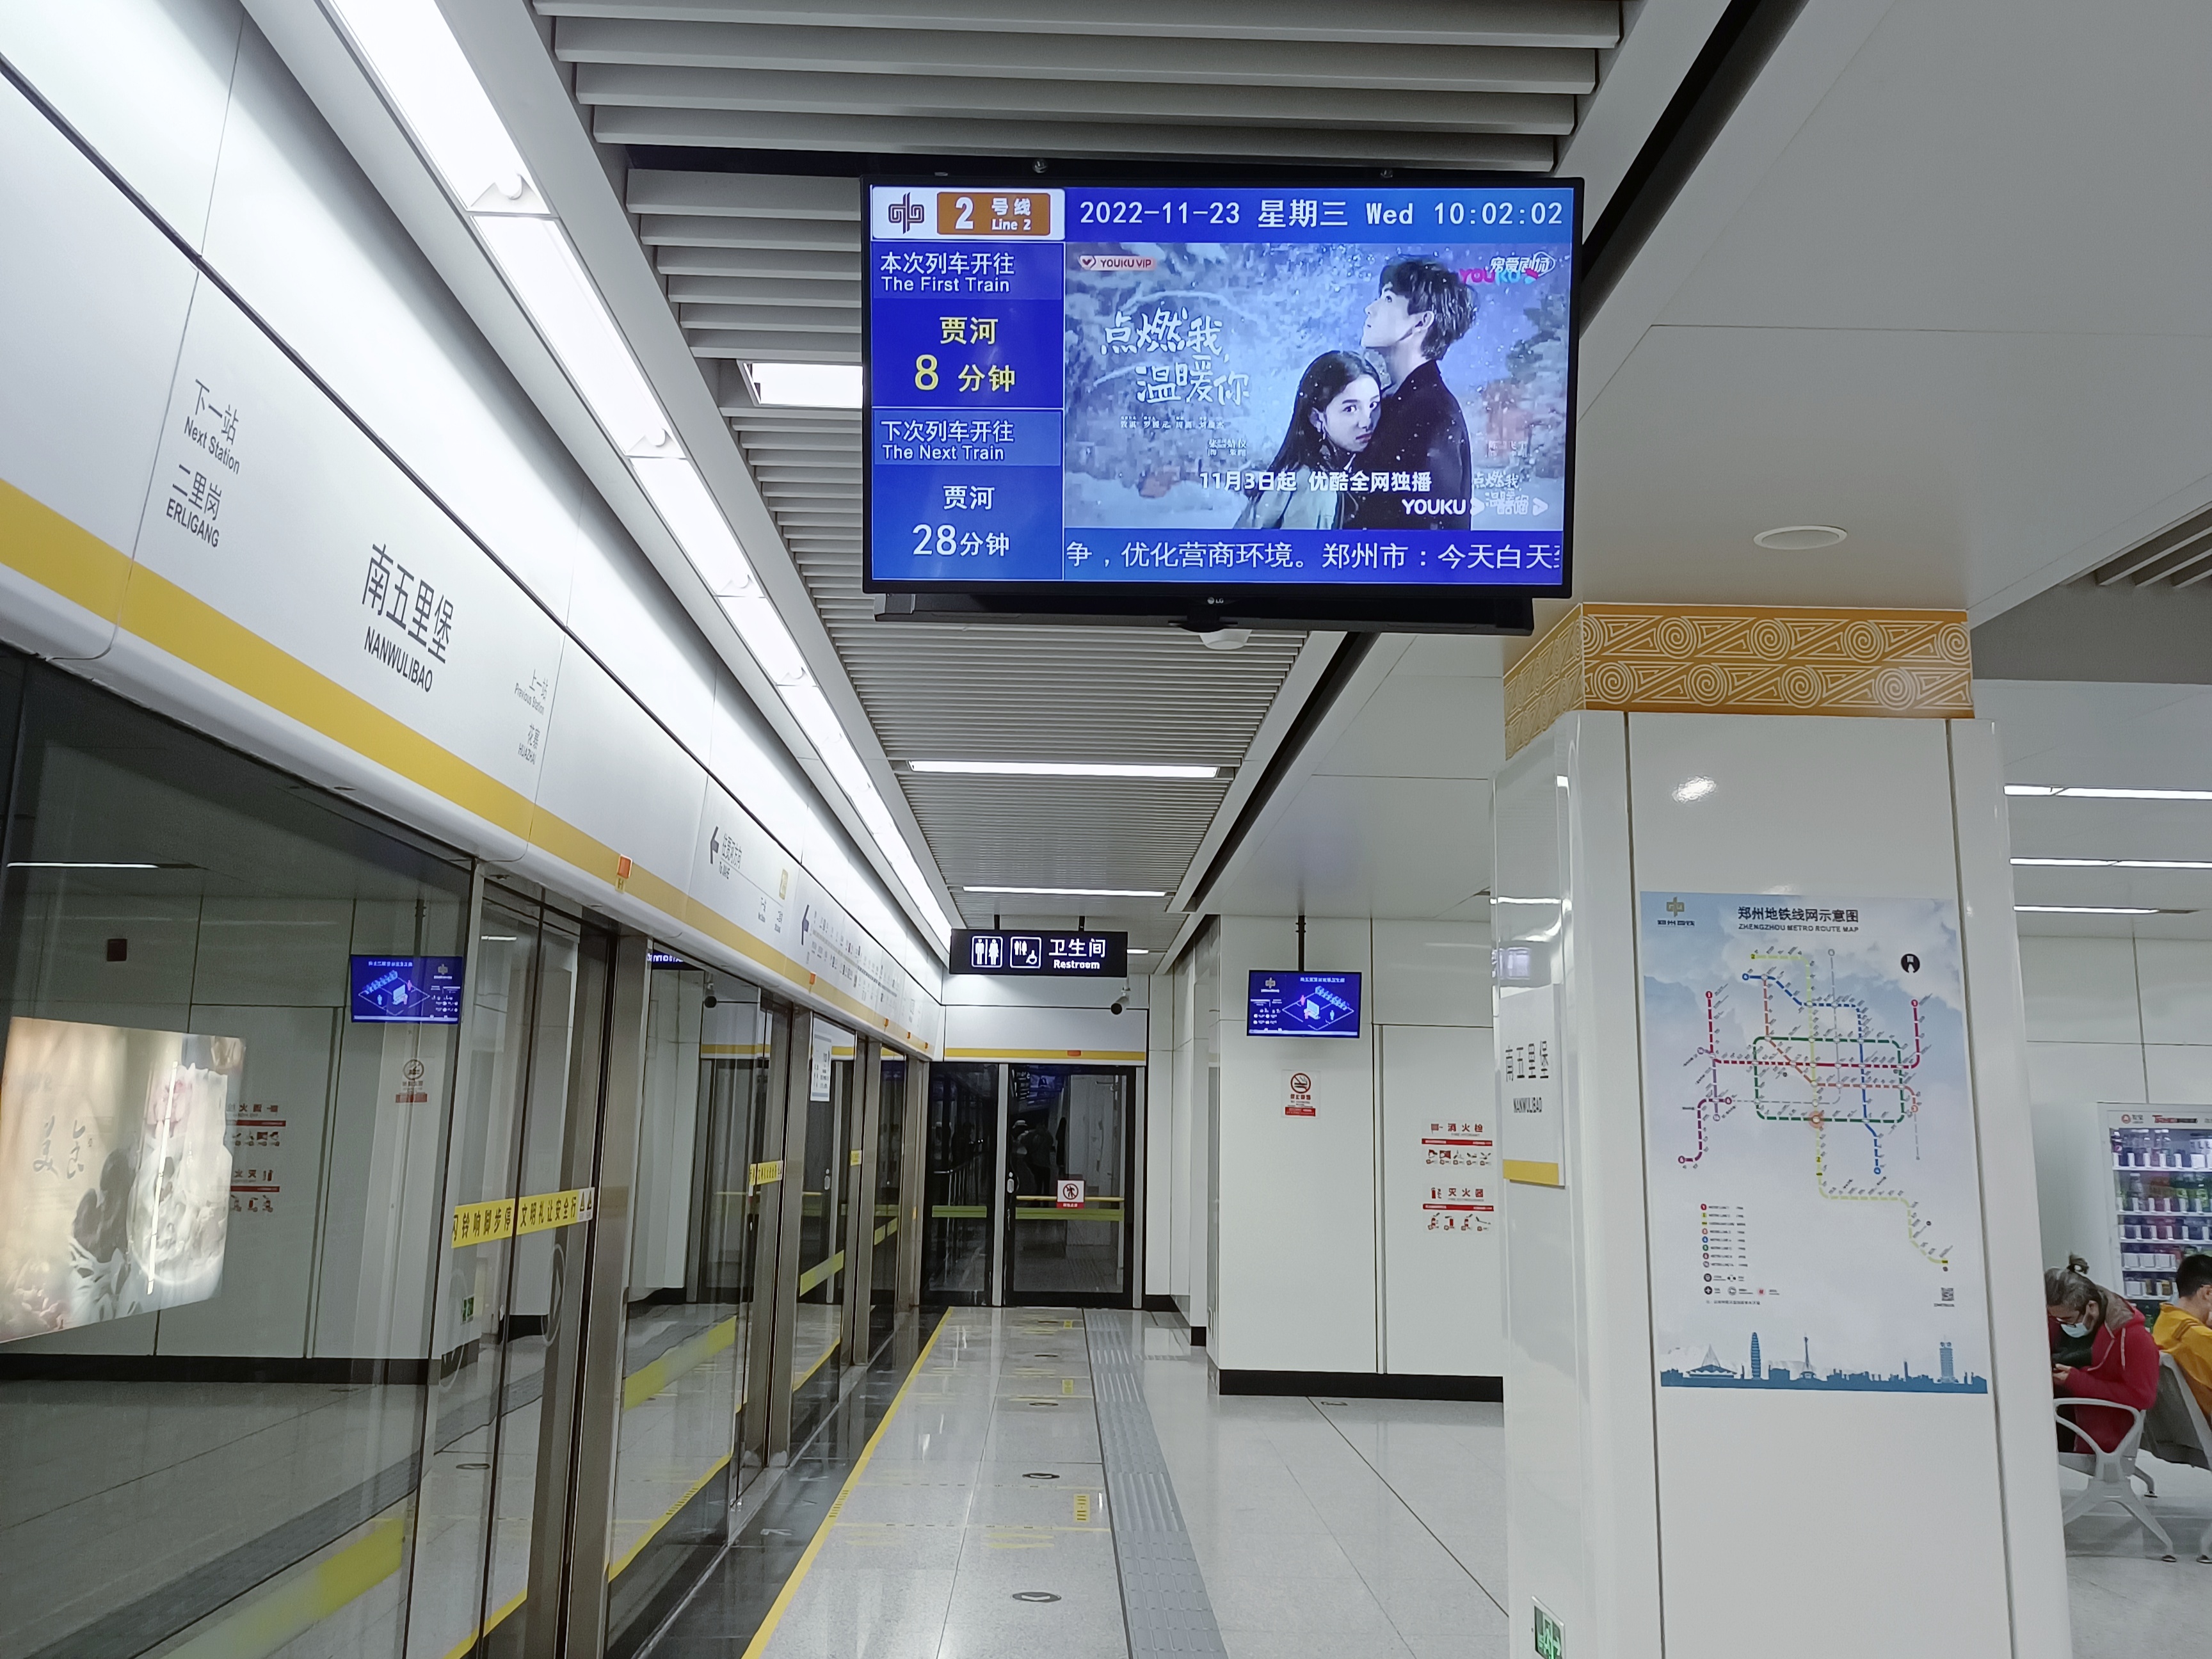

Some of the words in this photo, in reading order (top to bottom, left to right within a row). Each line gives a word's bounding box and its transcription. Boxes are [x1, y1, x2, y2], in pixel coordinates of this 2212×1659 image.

[955, 197, 974, 230] 2
[991, 198, 1031, 216] 号线
[991, 219, 1018, 232] Line
[1023, 220, 1031, 231] 2
[1080, 201, 1240, 225] 2022-11-23
[1258, 199, 1348, 228] 星期三
[1366, 202, 1413, 225] Wed
[1434, 202, 1563, 225] 10:02:02
[880, 251, 1015, 276] 本次列车开往
[1100, 258, 1134, 269] YOUKU
[1135, 259, 1152, 269] VIP
[881, 276, 916, 293] The
[920, 276, 960, 293] First
[965, 276, 1010, 293] Train
[939, 316, 998, 345] 贾河
[915, 355, 939, 392] 8
[958, 364, 1016, 393] 分钟
[1134, 354, 1250, 405] 温暖你
[195, 379, 239, 445] 下一站
[881, 421, 1014, 444] 下次列车开往
[184, 416, 207, 449] Next
[208, 435, 240, 475] Station
[883, 445, 913, 460] The
[919, 446, 958, 460] Next
[961, 446, 1005, 461] Train
[172, 463, 222, 521] 二里岗
[1199, 471, 1297, 492] 11月3日起
[1308, 470, 1433, 493] 优酷全网独播
[943, 485, 996, 511] 贾河
[1401, 499, 1466, 515] YOUKU
[166, 497, 220, 548] ERLIGANG
[362, 543, 454, 664] 南五里堡
[364, 625, 433, 693] NANWULIBAO
[529, 669, 549, 701] 上一站
[1738, 906, 1859, 923] 郑州地铁线网示意图
[1048, 938, 1106, 958] 卫生间
[1054, 959, 1100, 970] Restroom
